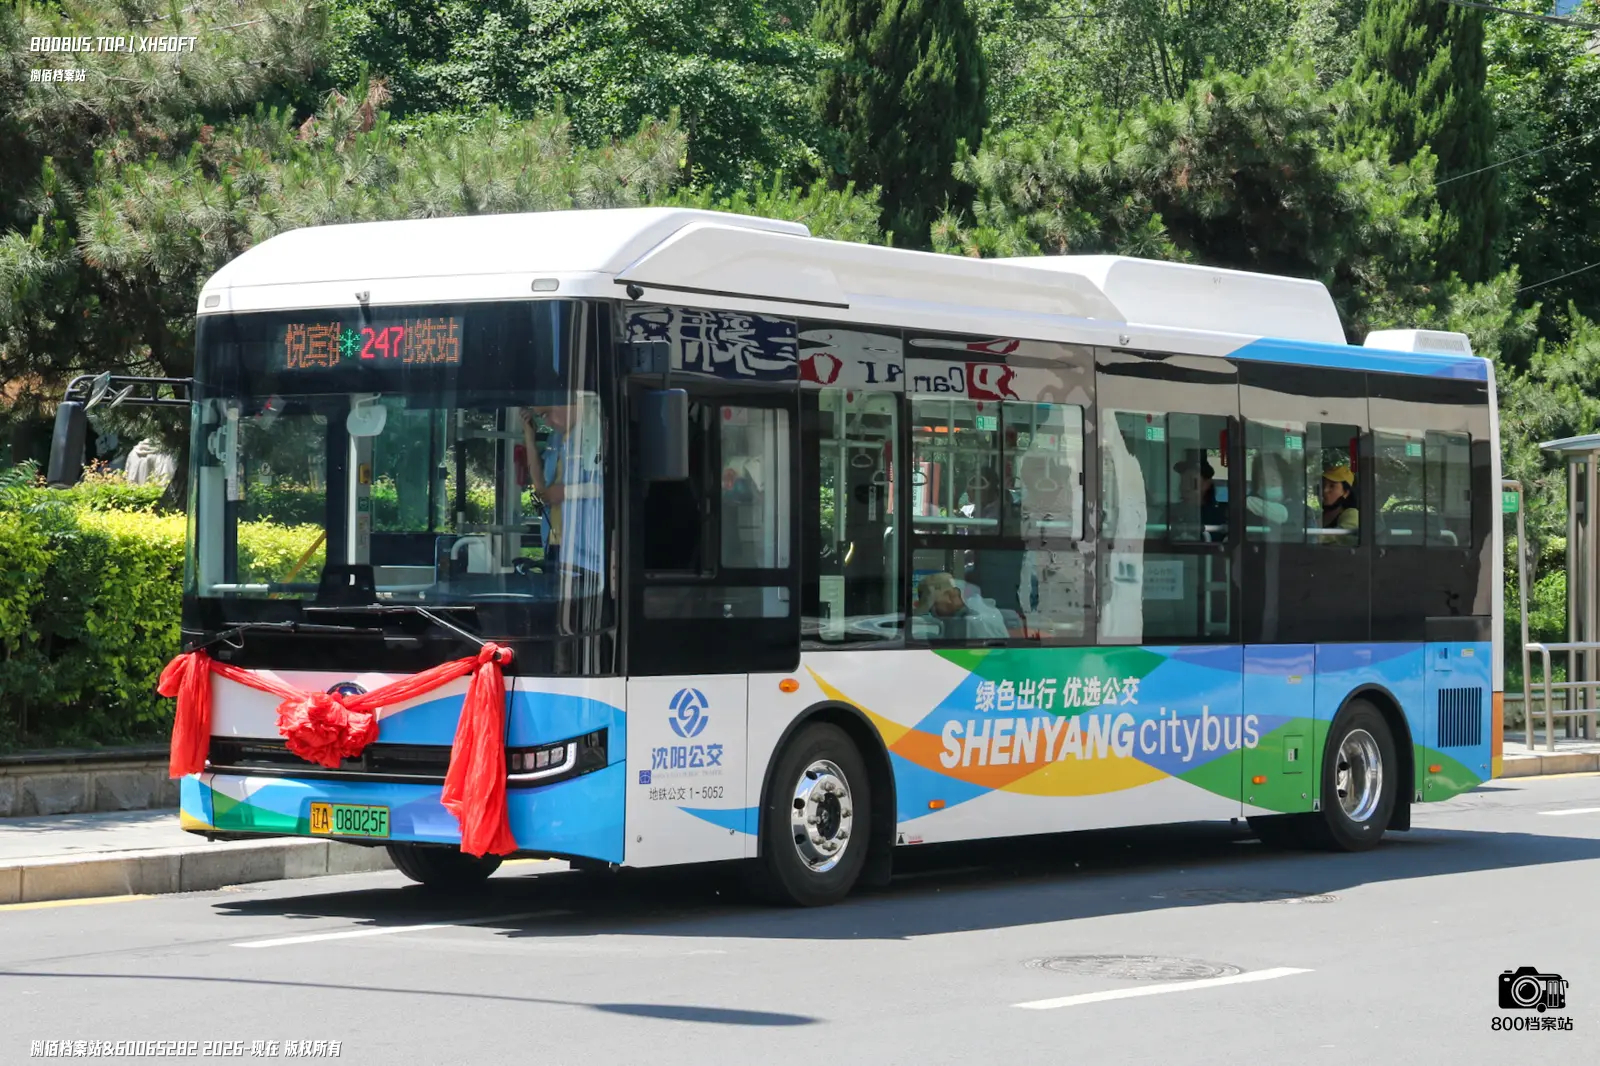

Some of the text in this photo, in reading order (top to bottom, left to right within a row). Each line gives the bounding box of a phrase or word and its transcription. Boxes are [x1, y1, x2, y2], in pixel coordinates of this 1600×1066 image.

[360, 325, 405, 359] 247
[975, 675, 1141, 712] 绿色出行 优选公交
[939, 705, 1260, 769] SHENYANG citybus
[651, 743, 724, 770] 沈阳公交
[649, 787, 686, 801] 地铁公交
[336, 808, 387, 833] 08025F
